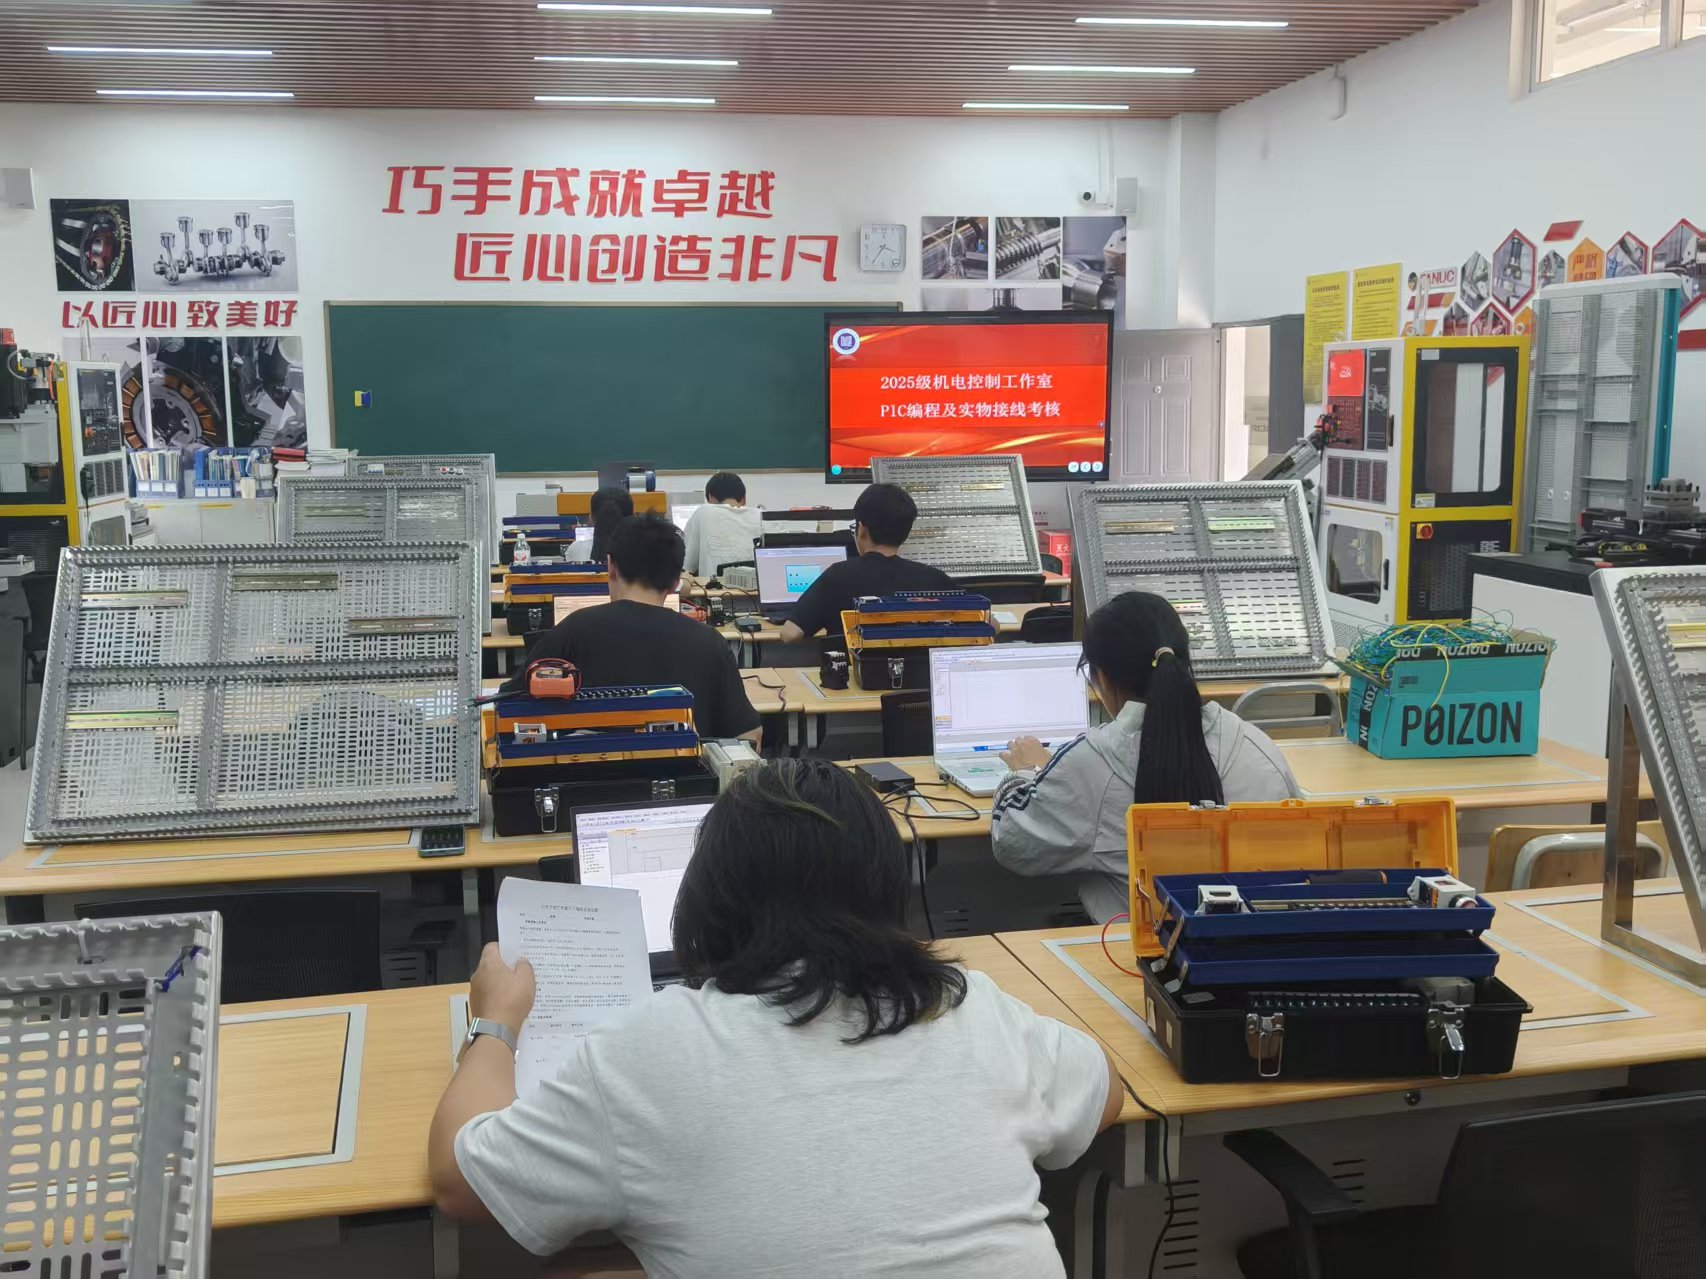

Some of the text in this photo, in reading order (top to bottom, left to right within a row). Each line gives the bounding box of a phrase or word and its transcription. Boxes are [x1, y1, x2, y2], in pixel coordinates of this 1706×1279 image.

[382, 166, 776, 219] 巧手成就卓越
[453, 232, 839, 283] 匠心创造非凡
[61, 300, 298, 329] 以匠心致美好
[880, 373, 1053, 390] 2025级机电控制工作室
